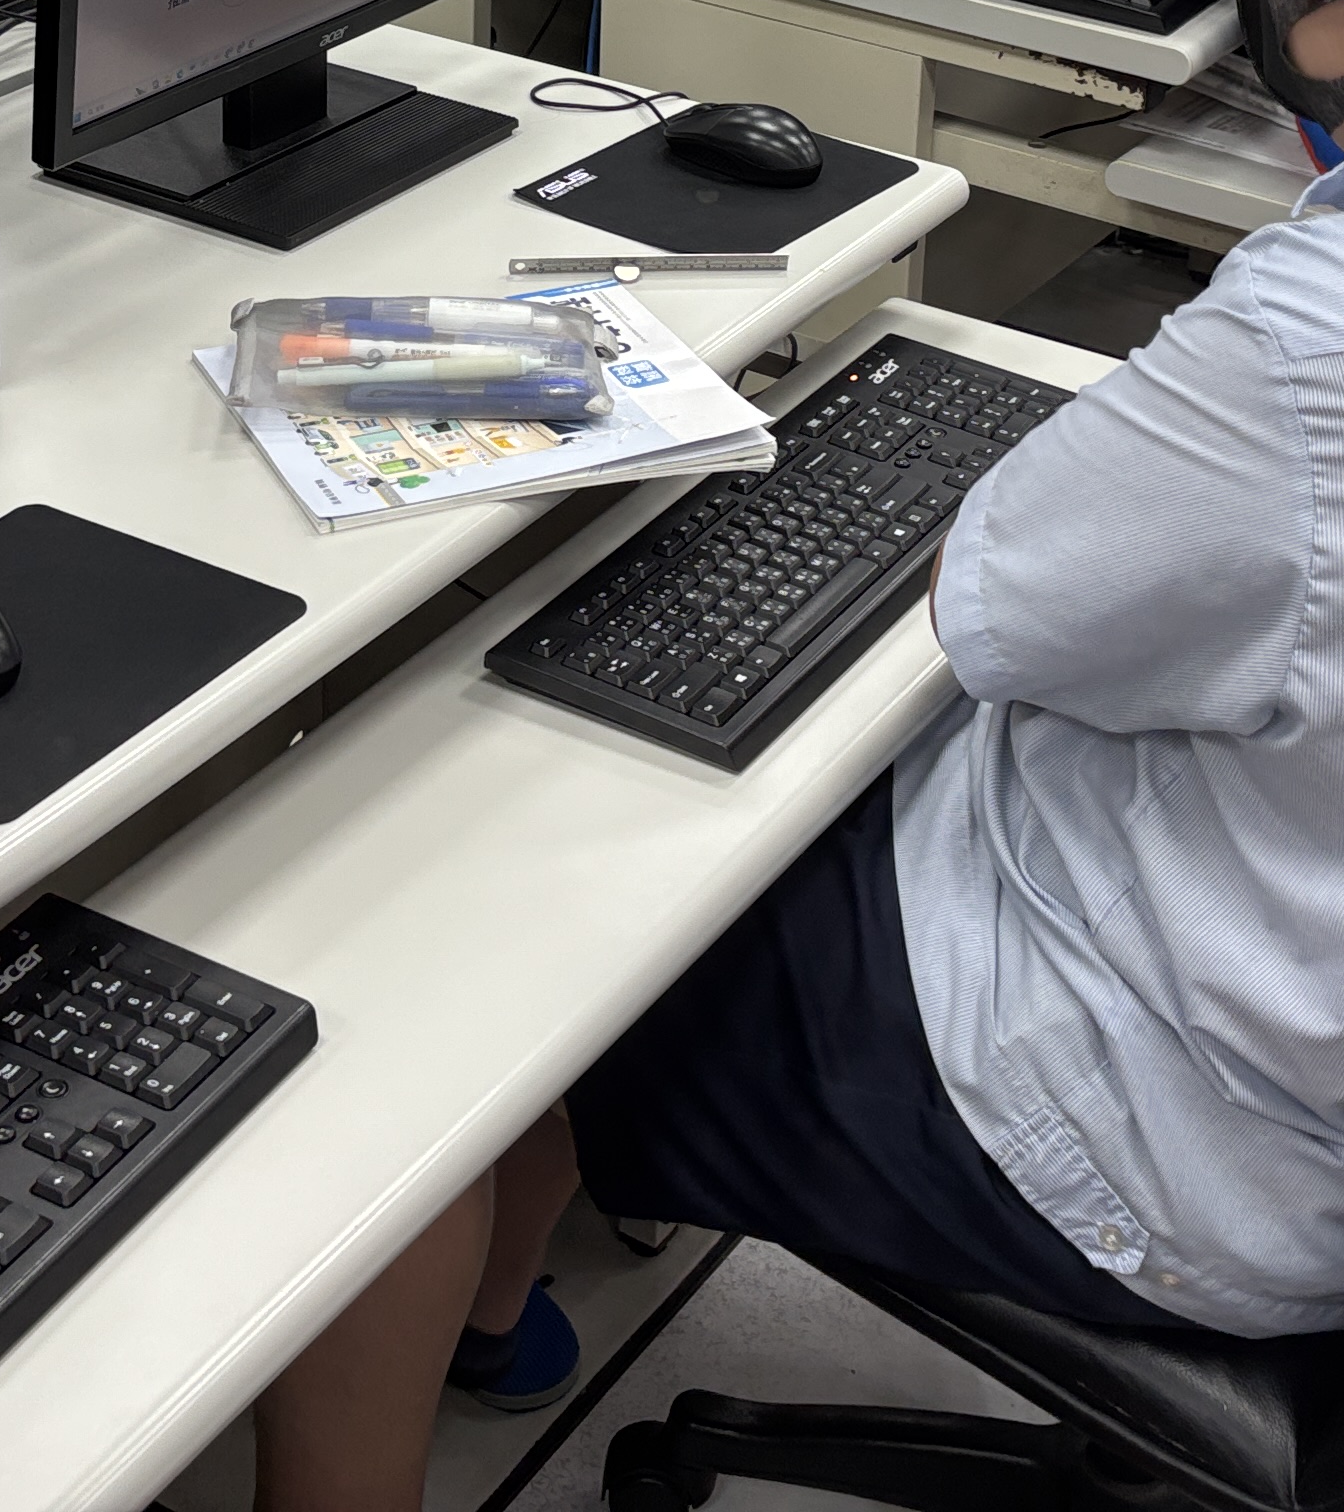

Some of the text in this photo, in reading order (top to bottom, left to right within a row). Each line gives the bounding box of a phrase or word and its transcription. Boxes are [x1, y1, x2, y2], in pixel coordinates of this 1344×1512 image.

[320, 25, 348, 47] acer
[536, 168, 589, 198] ASUS
[868, 359, 899, 384] acer
